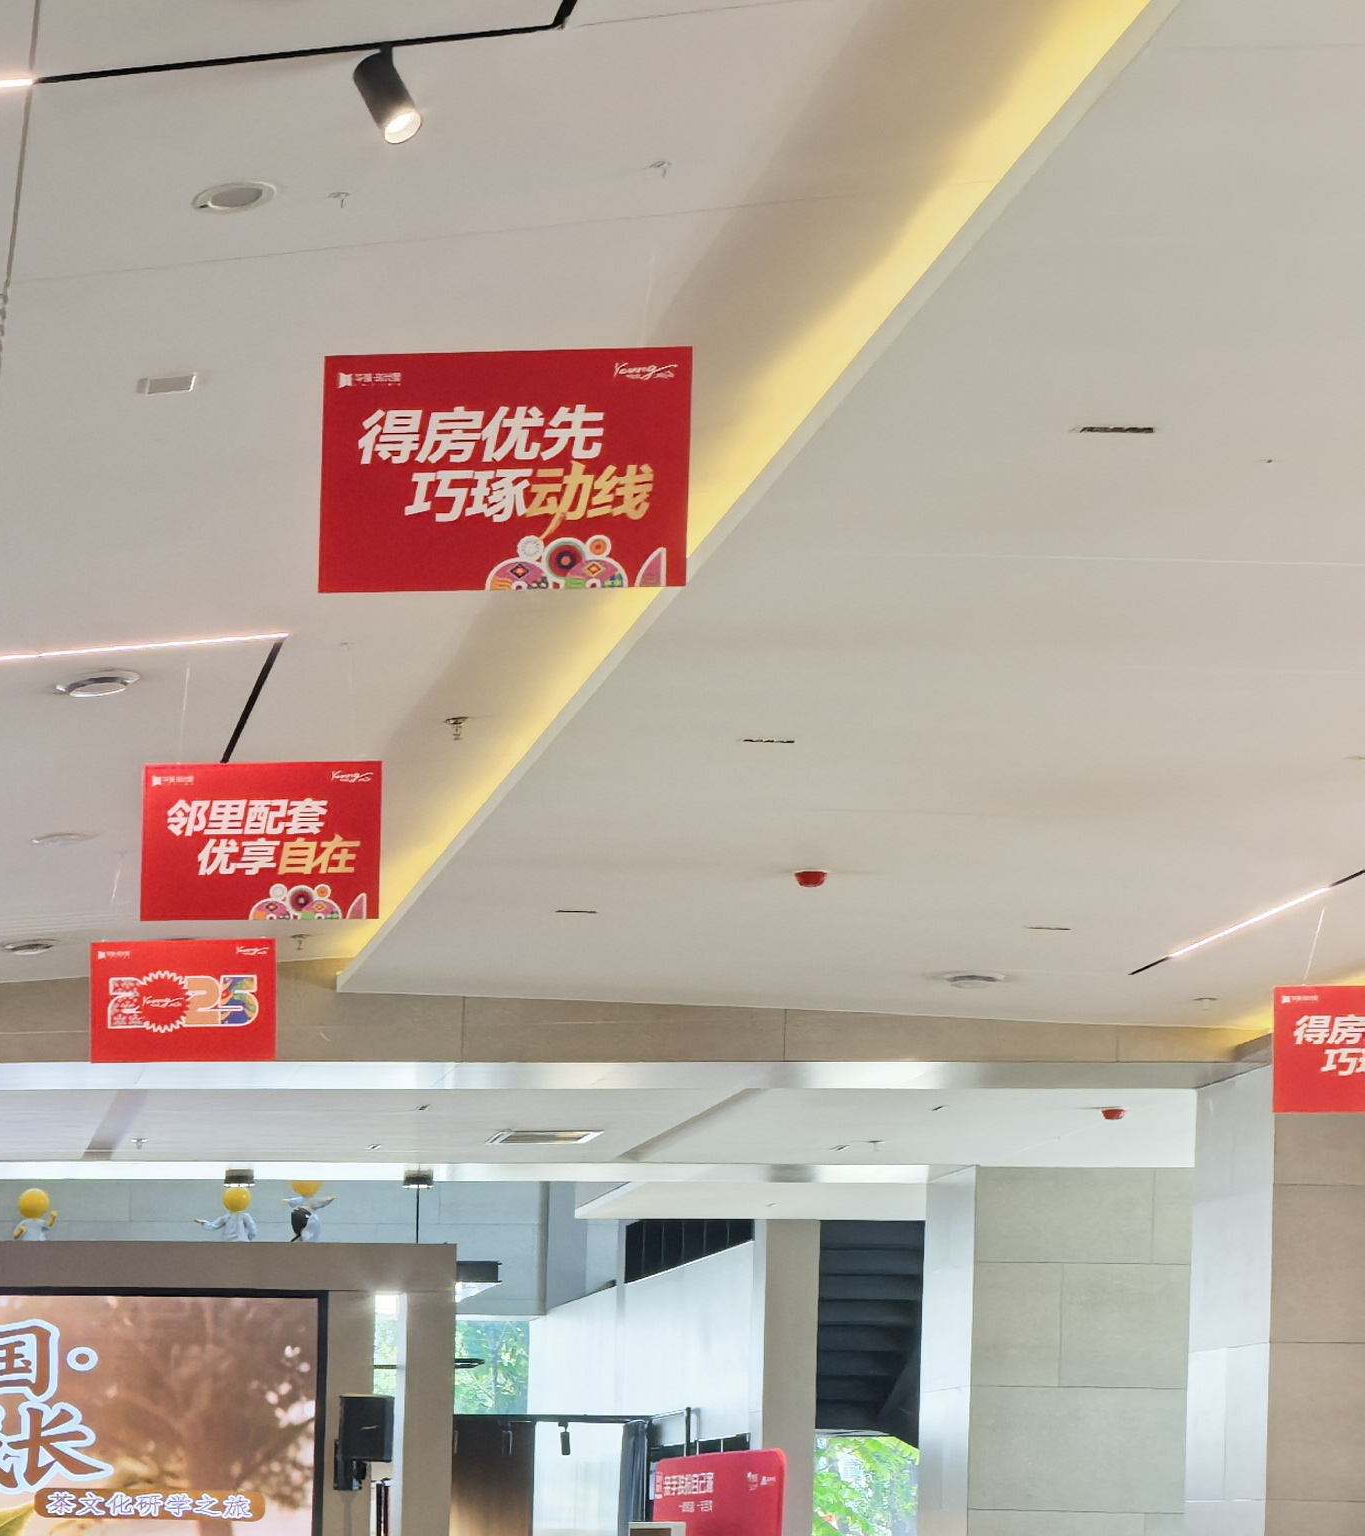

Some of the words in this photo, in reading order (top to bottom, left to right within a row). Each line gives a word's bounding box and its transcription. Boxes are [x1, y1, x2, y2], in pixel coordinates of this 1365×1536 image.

[358, 404, 604, 465] 得房优先
[404, 460, 654, 540] 巧琢动线
[167, 798, 328, 837] 邻里配套
[197, 833, 361, 876] 优享自在
[1293, 1014, 1365, 1045] 得房
[1321, 1048, 1365, 1076] 巧
[46, 1491, 253, 1519] 茶文化研学之旅
